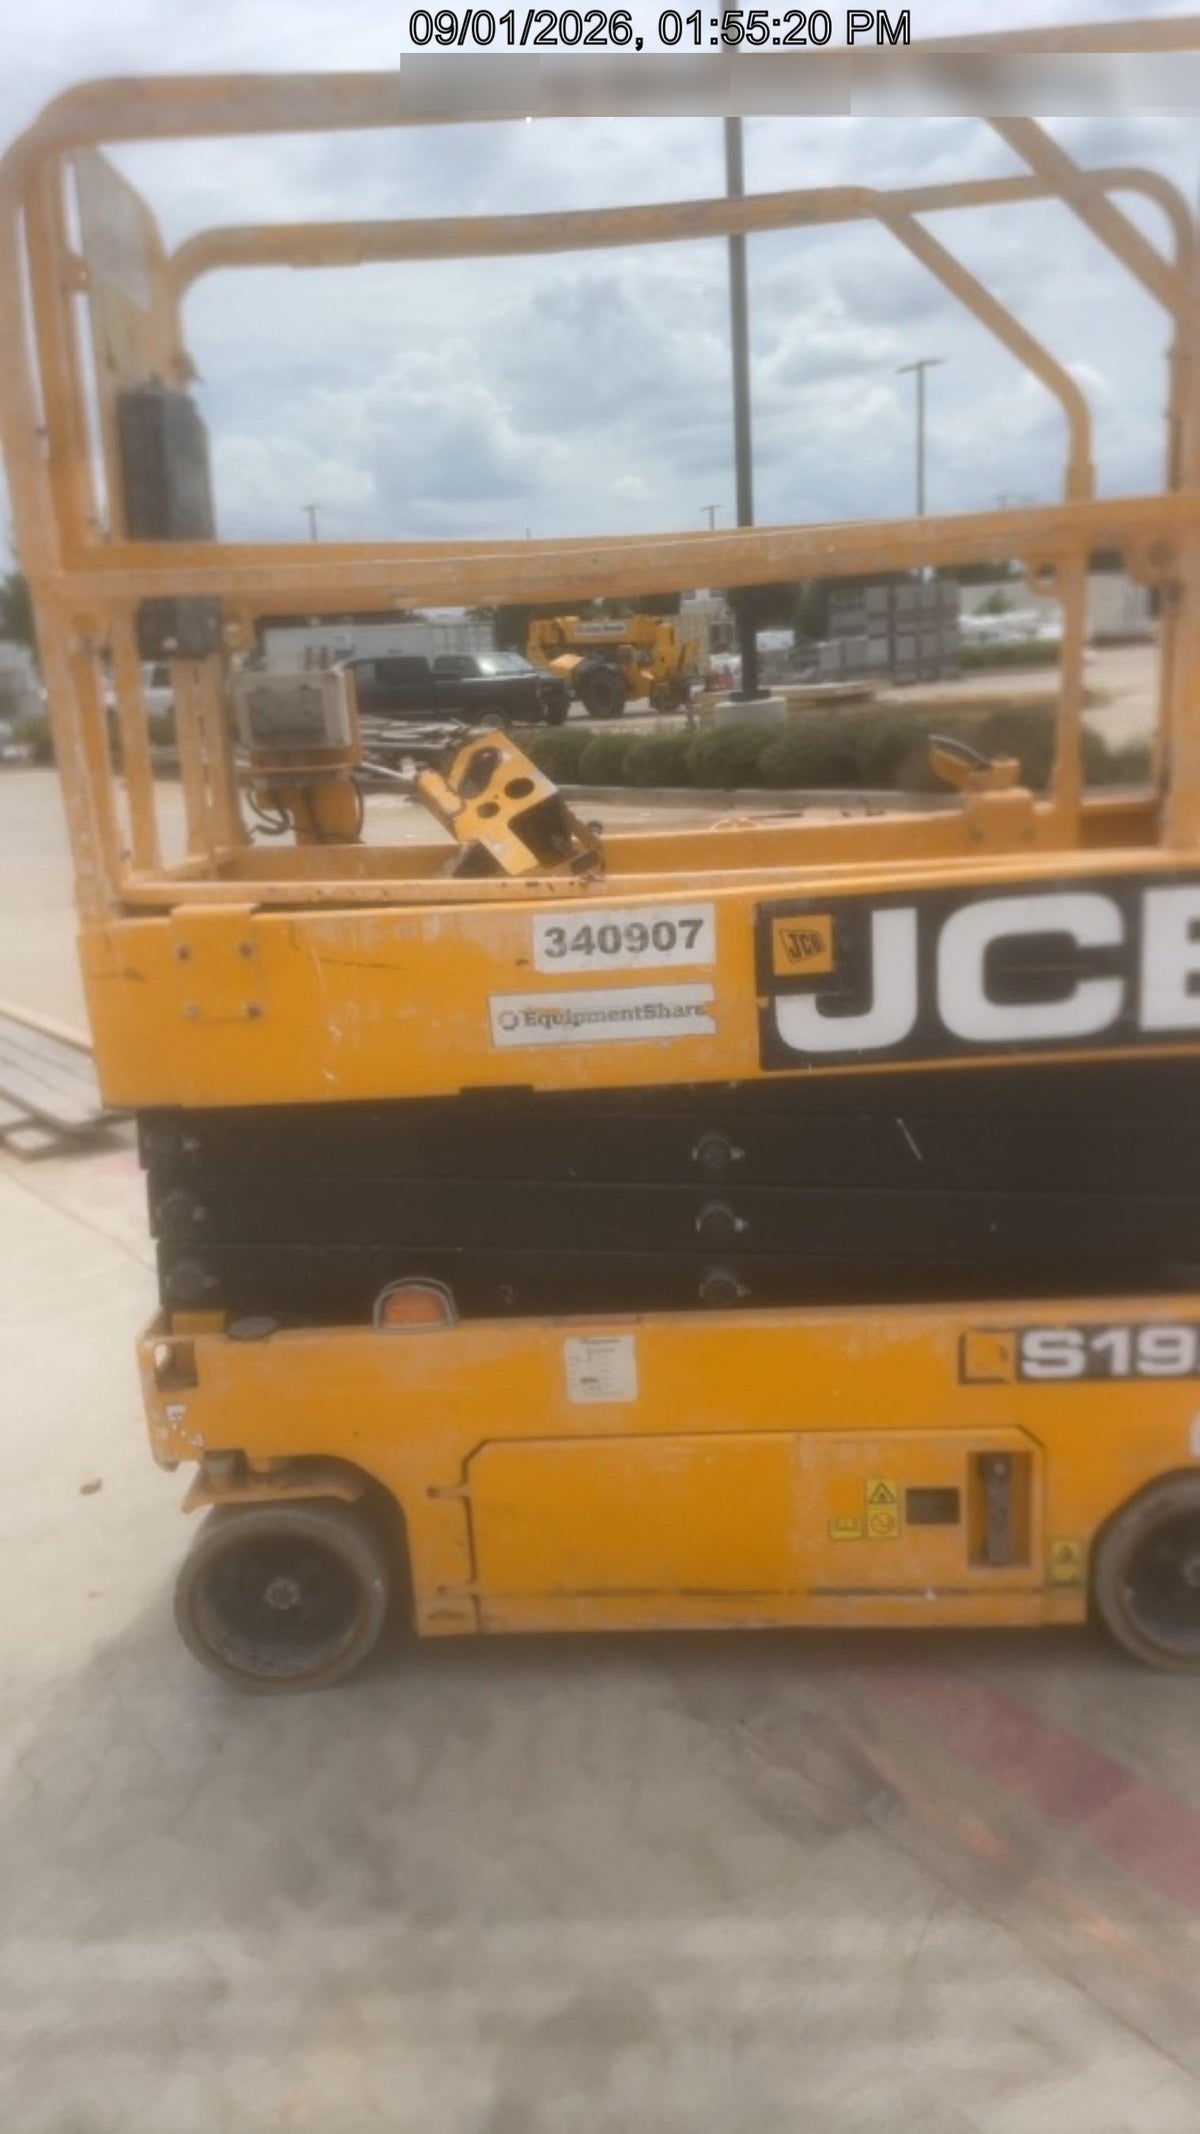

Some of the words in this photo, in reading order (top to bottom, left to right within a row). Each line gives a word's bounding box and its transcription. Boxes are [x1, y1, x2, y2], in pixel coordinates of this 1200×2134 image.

[543, 918, 704, 958] 340907
[788, 932, 824, 959] JCB
[1021, 1326, 1200, 1378] S19
